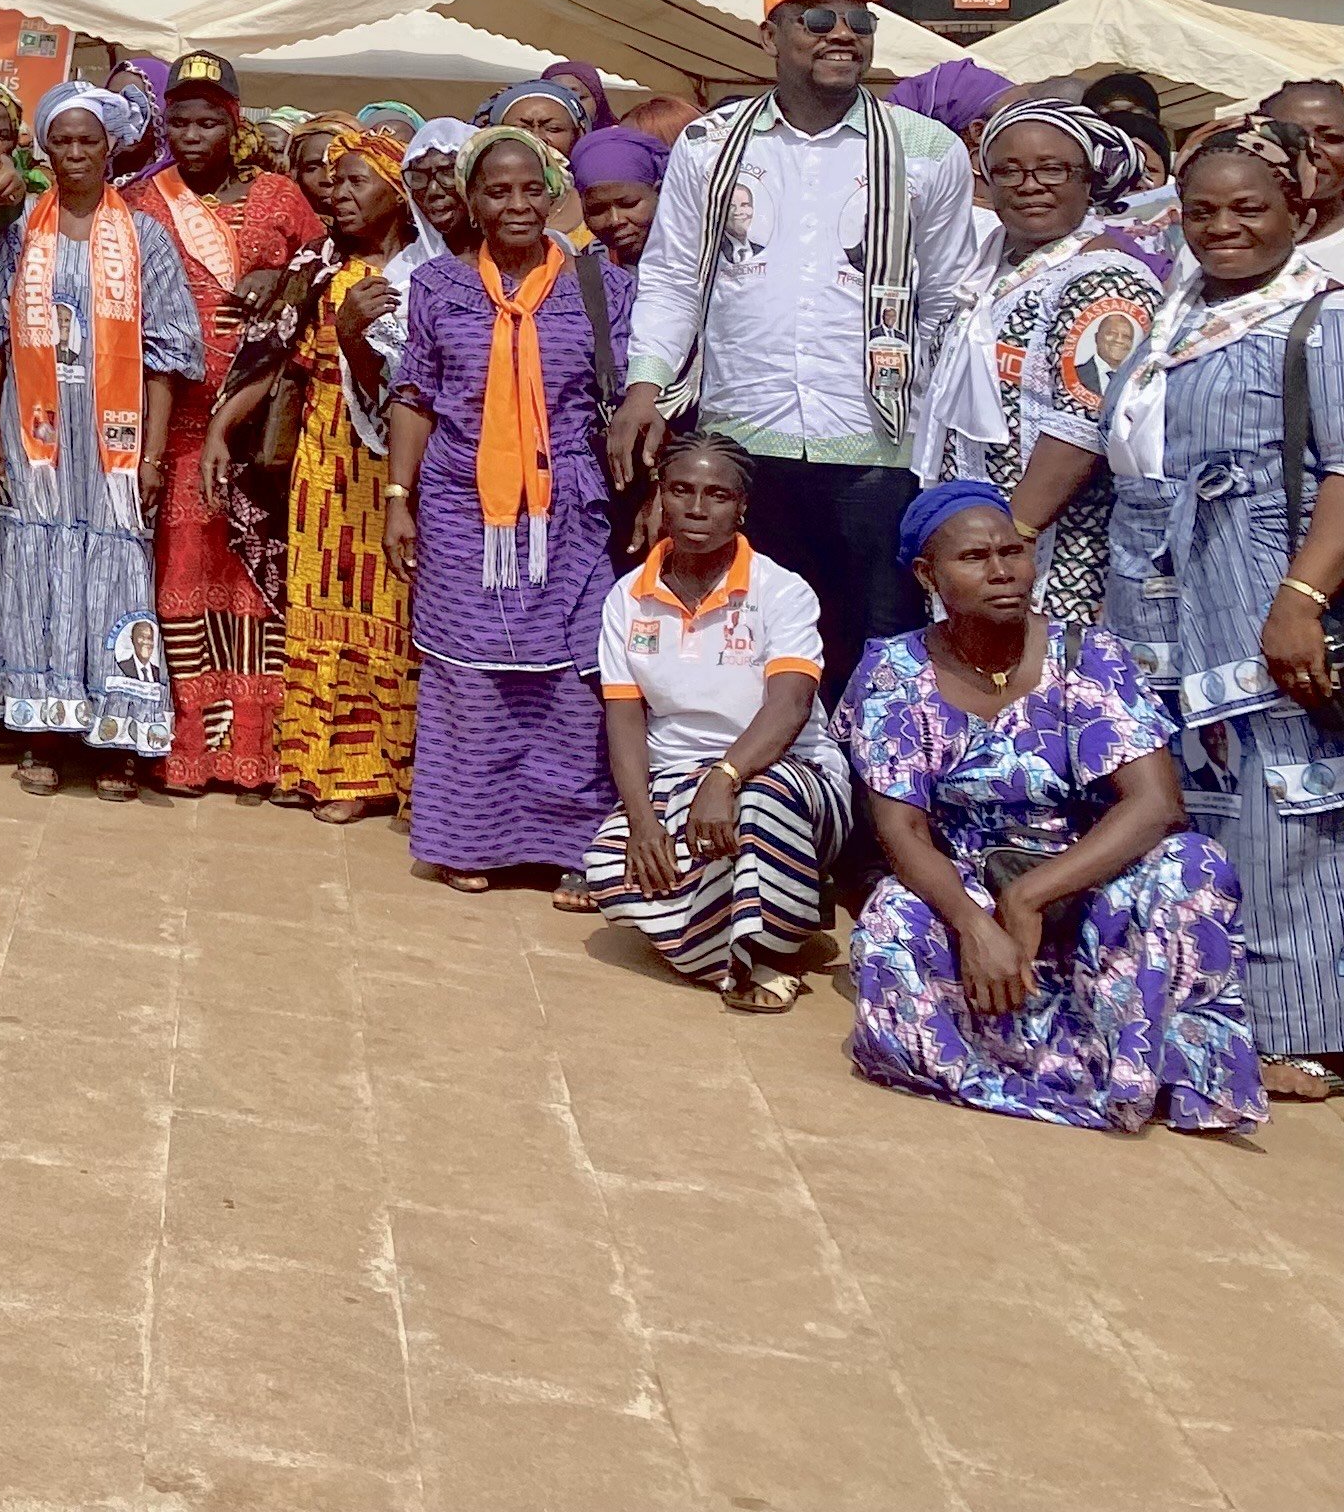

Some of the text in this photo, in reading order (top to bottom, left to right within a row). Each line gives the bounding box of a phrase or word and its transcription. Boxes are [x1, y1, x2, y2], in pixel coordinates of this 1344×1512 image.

[99, 220, 126, 301] RHDP
[25, 246, 47, 327] RHDP
[1077, 301, 1138, 335] ALASSANE
[875, 356, 901, 366] RHDP
[104, 410, 138, 424] RHDP
